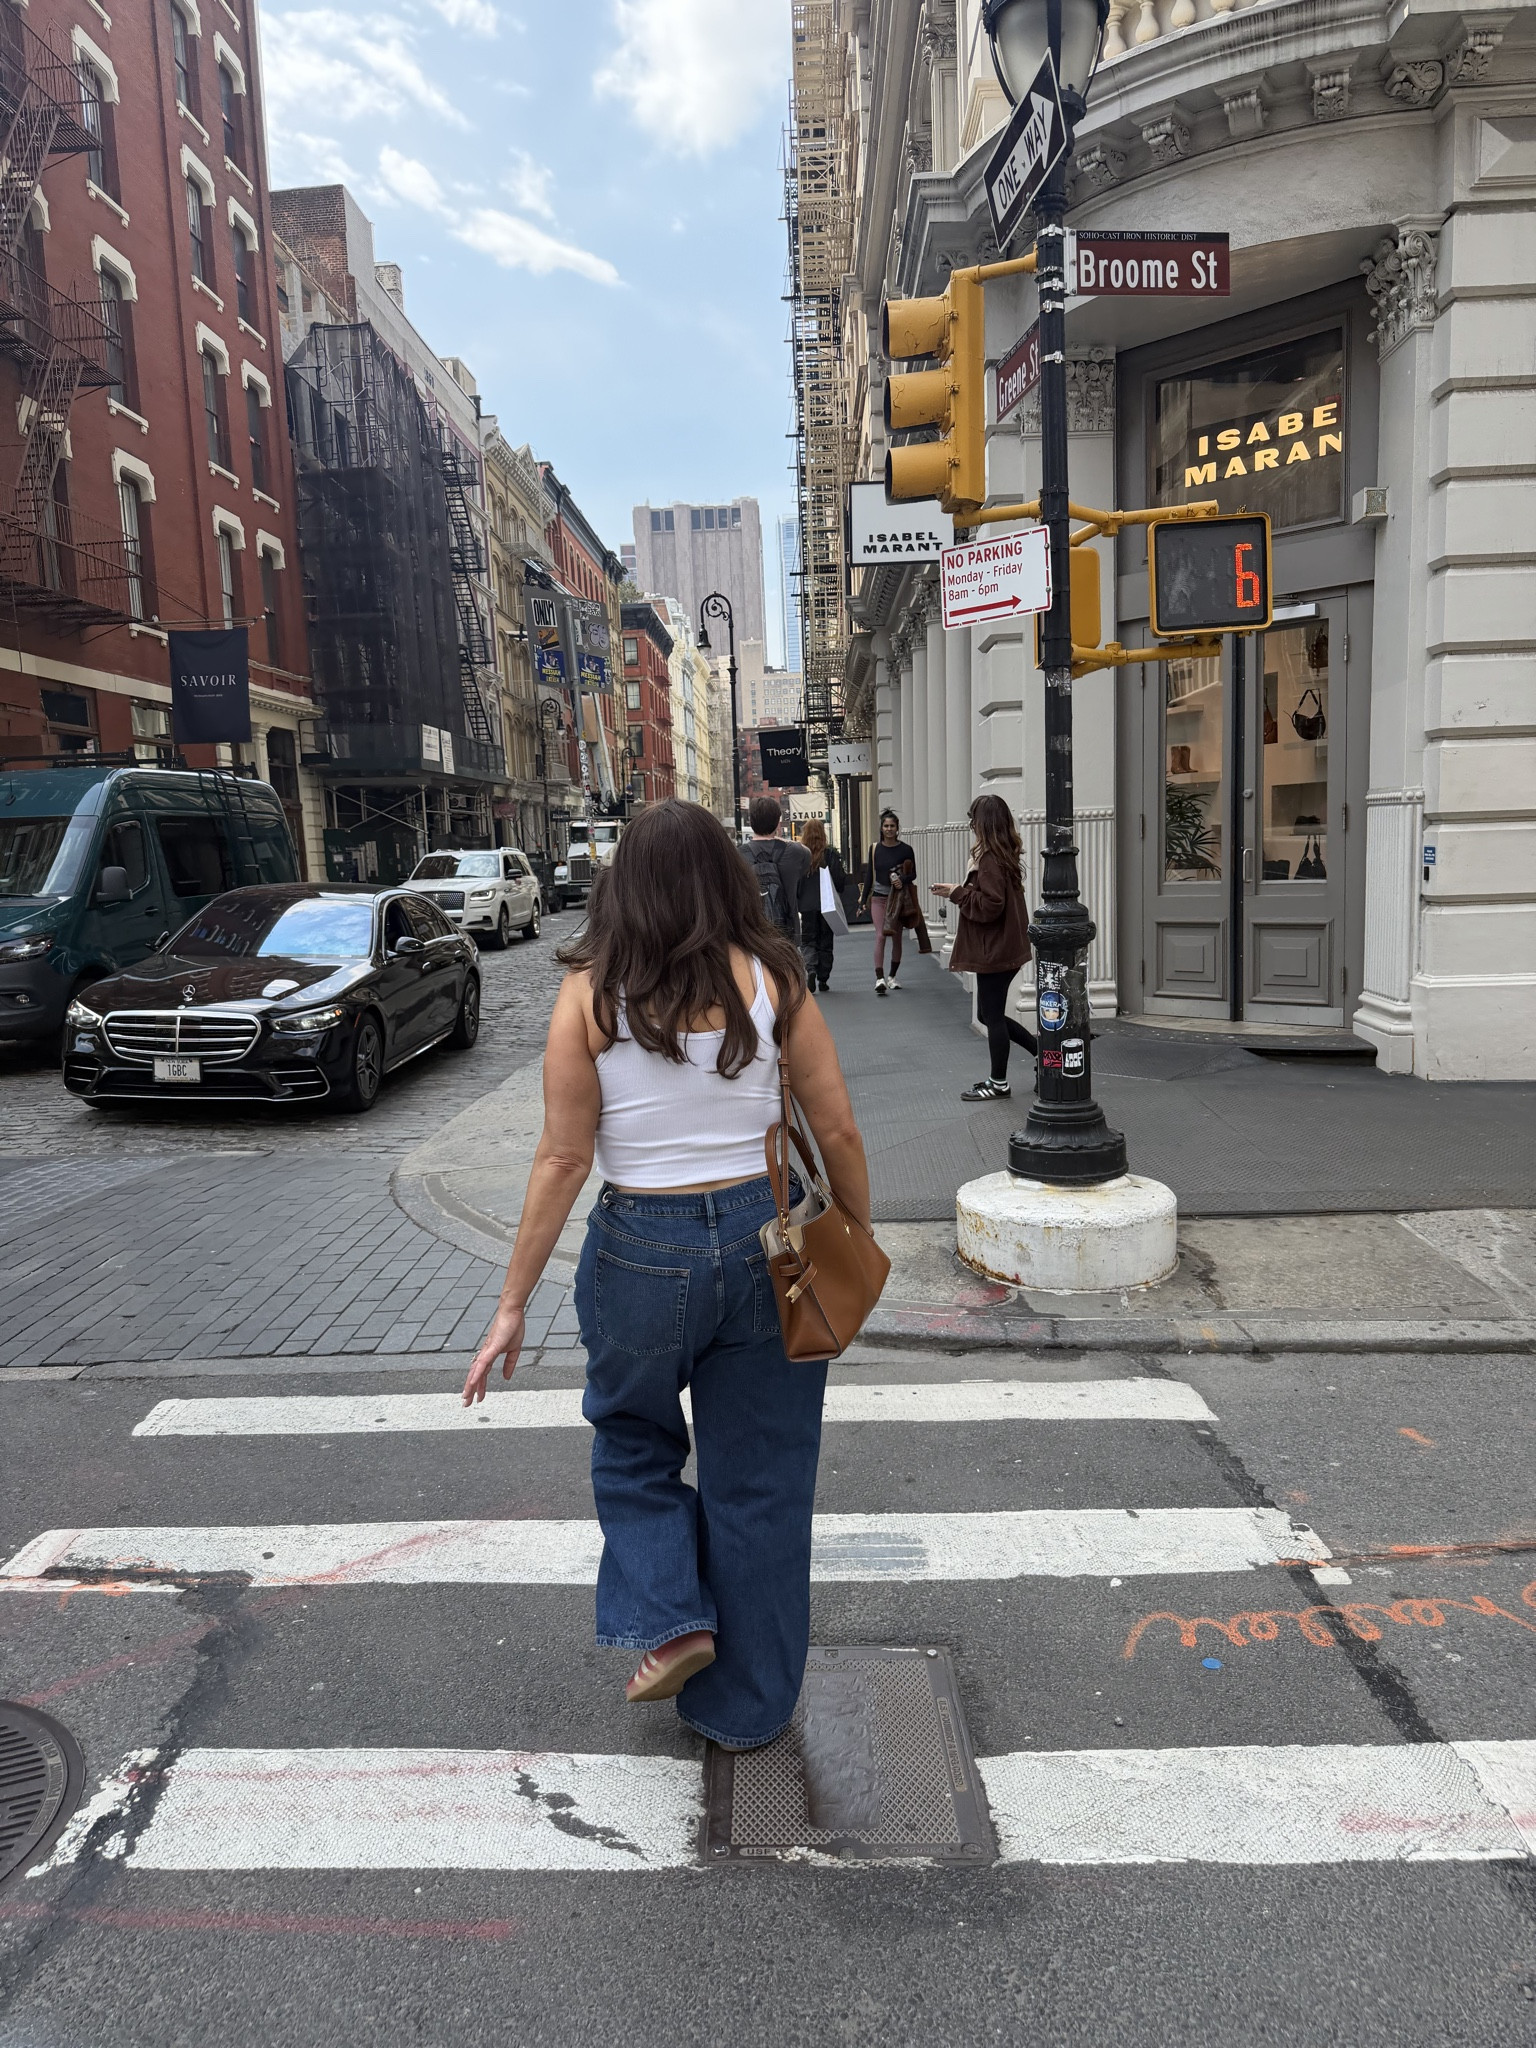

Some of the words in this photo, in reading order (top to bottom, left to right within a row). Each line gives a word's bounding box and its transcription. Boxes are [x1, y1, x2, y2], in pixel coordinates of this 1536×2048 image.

[998, 155, 1021, 210] ONE
[1024, 101, 1047, 166] WAY
[1079, 232, 1120, 240] SOHO-CAST
[1123, 232, 1142, 240] IRON
[1144, 233, 1179, 241] HISTORIC
[1181, 233, 1198, 241] DIST
[1079, 249, 1179, 289] Broome
[1191, 250, 1218, 289] St
[999, 361, 1027, 412] Greene
[1029, 338, 1039, 381] St
[1198, 402, 1338, 457] ISABE
[1185, 431, 1342, 488] MARAN
[863, 542, 943, 554] MARANT
[869, 531, 938, 543] ISABEL
[947, 554, 964, 570] NO
[968, 541, 1023, 566] PARKING
[948, 570, 984, 587] Monday
[993, 562, 1023, 578] Friday
[1235, 543, 1260, 608] 6
[949, 589, 969, 601] 8am
[979, 582, 999, 597] 6pm
[180, 674, 237, 687] SAVOIR
[766, 746, 802, 757] Theory
[792, 811, 824, 820] STAUD
[167, 1064, 187, 1077] 1GBC
